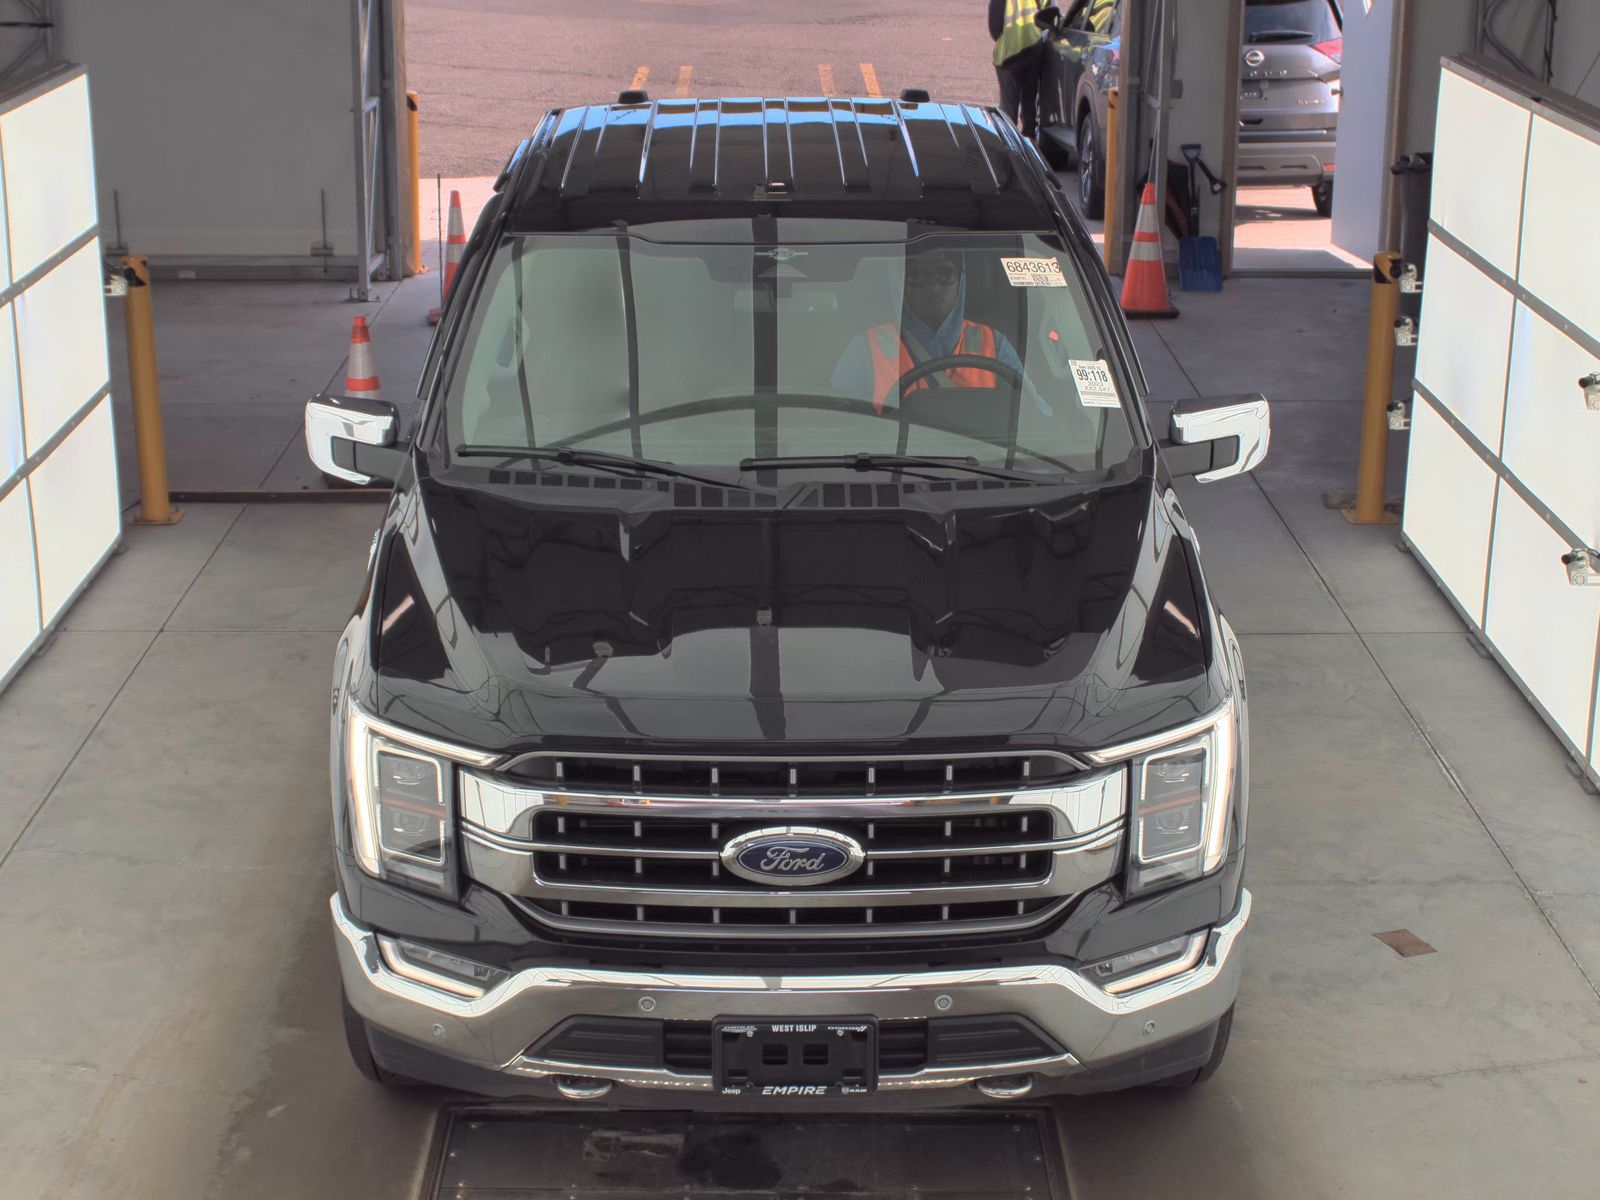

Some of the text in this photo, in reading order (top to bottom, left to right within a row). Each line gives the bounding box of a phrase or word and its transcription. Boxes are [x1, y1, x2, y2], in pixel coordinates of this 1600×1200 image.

[1006, 261, 1061, 273] 6843613
[1076, 368, 1108, 382] 99:118
[760, 846, 826, 871] Ford
[771, 1024, 817, 1032] WEST ISLIP
[722, 1087, 741, 1095] Jeep
[762, 1086, 827, 1095] EMPIRE
